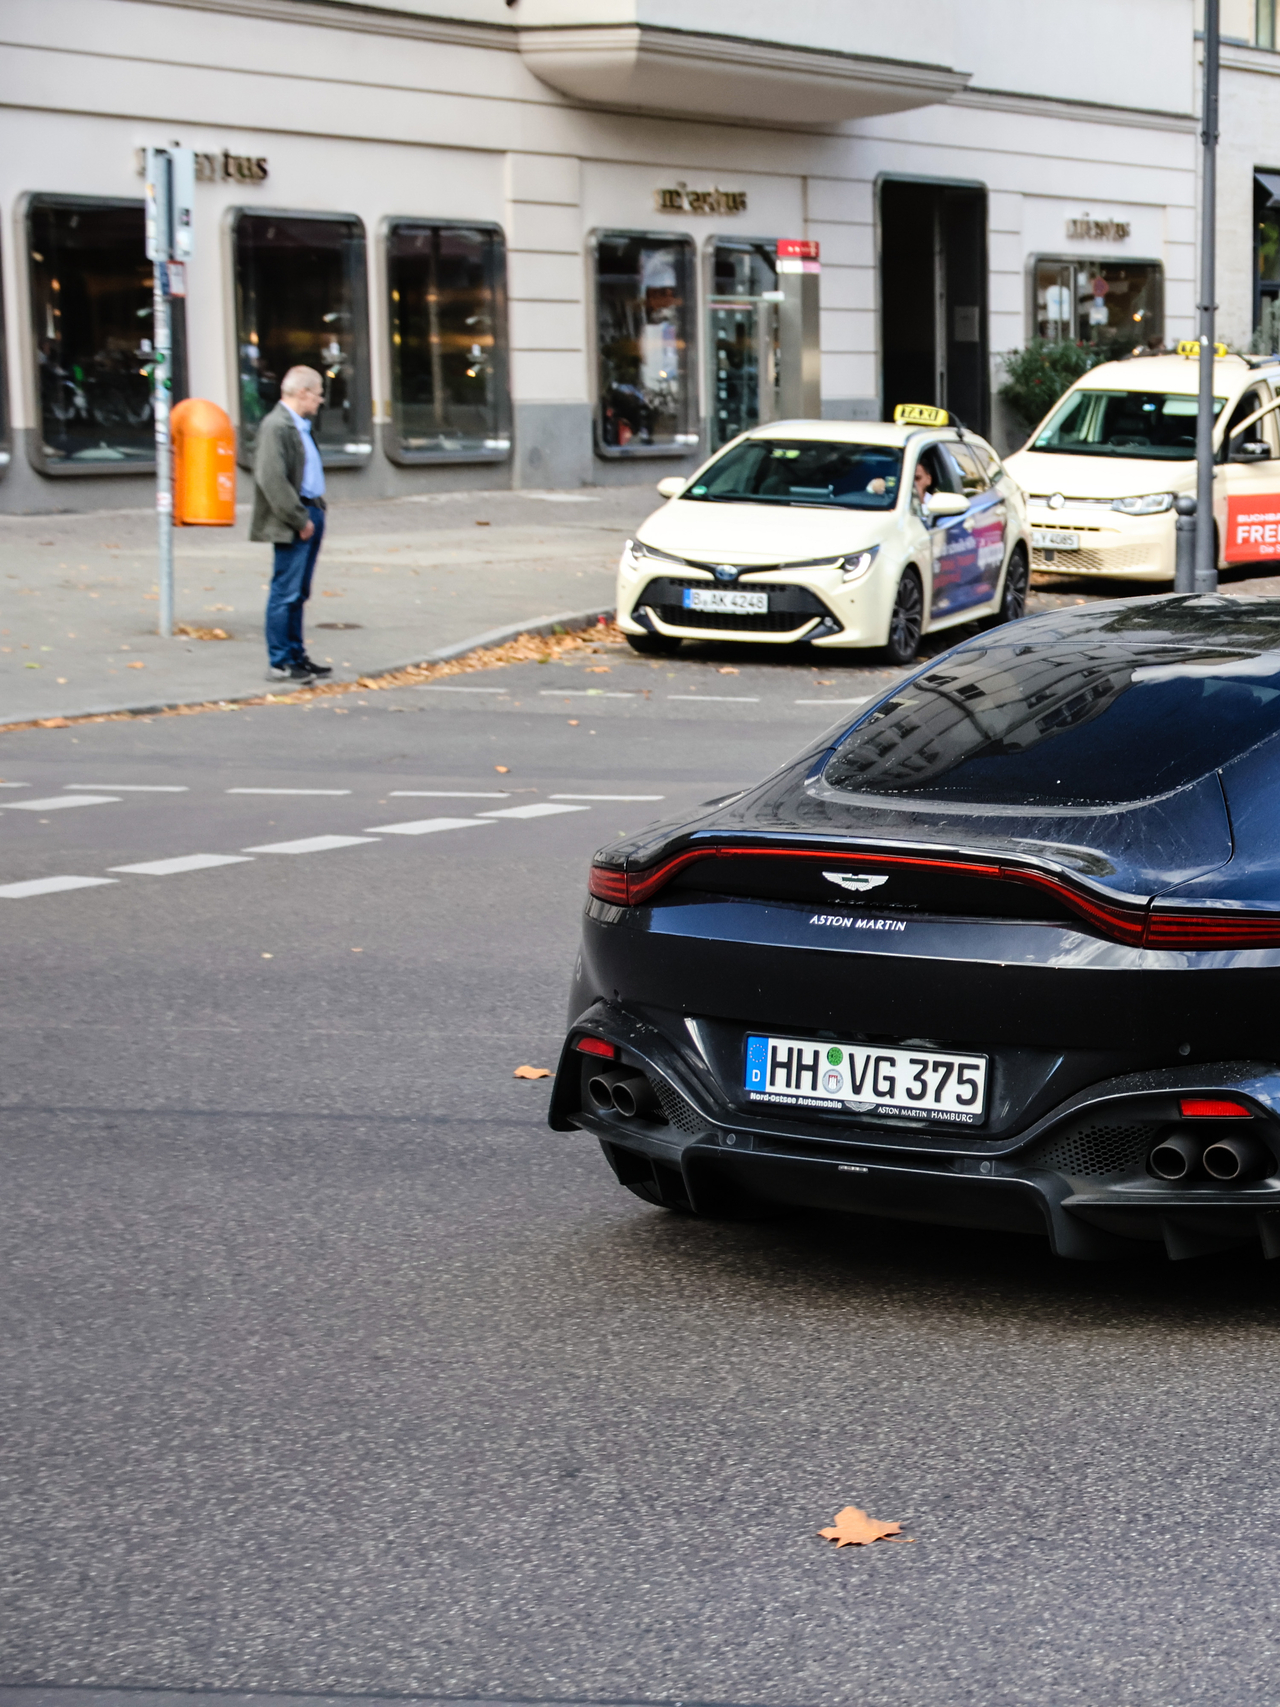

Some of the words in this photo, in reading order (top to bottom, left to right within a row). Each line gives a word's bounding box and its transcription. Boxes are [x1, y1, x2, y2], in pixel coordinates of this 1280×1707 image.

[901, 407, 938, 421] TAXI
[1259, 544, 1275, 554] Die
[693, 592, 700, 606] B
[711, 593, 728, 607] AK
[809, 914, 854, 928] ASTON
[855, 918, 907, 932] MARTIN
[752, 1069, 761, 1082] D
[769, 1045, 821, 1091] HH
[848, 1053, 897, 1099] VG
[906, 1058, 981, 1106] 375
[750, 1092, 797, 1105] Nord-Ostsee
[798, 1098, 843, 1110] Automobile
[877, 1106, 900, 1115] ASTON
[901, 1108, 928, 1118] MARTIN
[931, 1110, 974, 1123] HAMBURG
